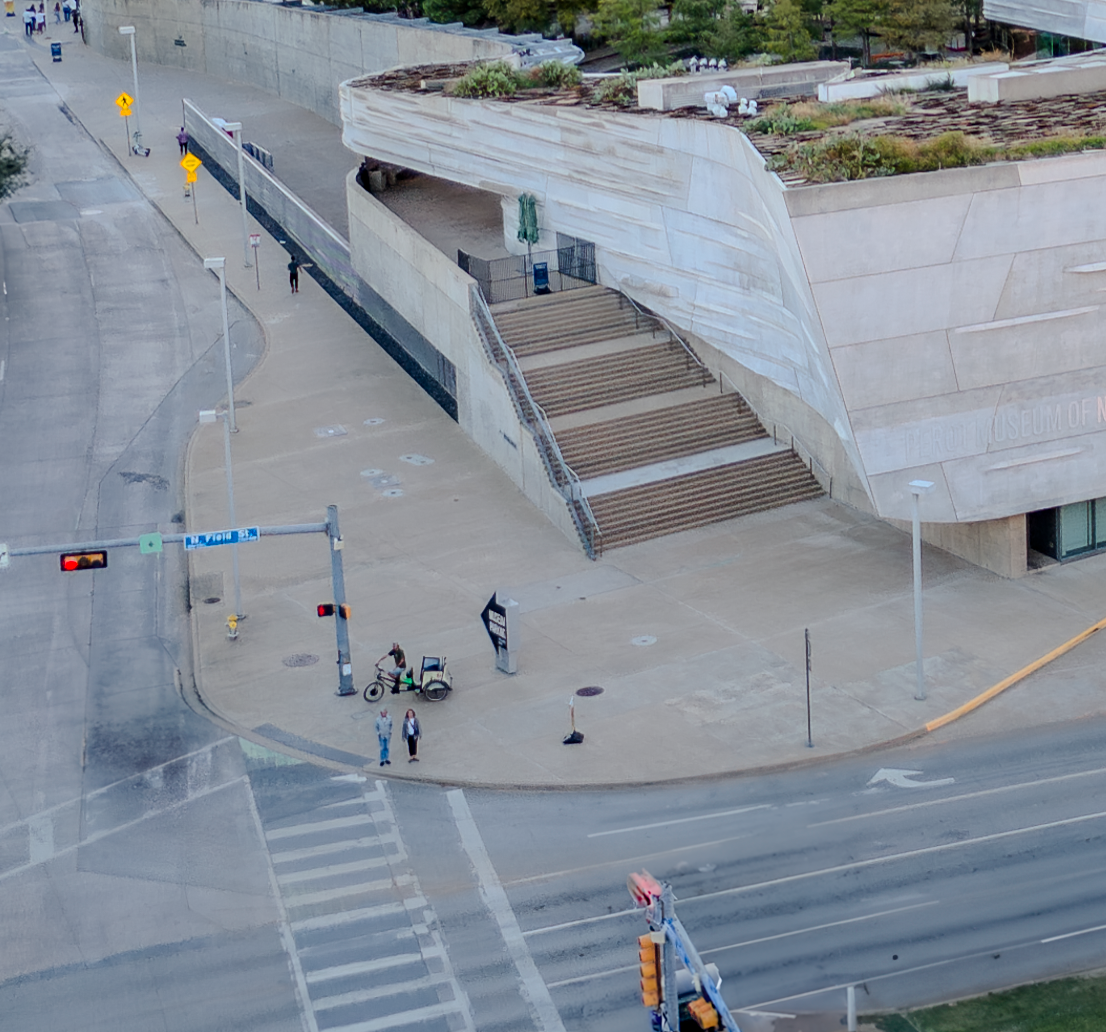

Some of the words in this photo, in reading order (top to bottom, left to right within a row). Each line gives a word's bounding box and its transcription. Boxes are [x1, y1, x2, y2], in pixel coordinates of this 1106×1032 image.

[975, 403, 1061, 444] MUSEUM
[1068, 398, 1091, 429] OF
[205, 531, 231, 543] Field
